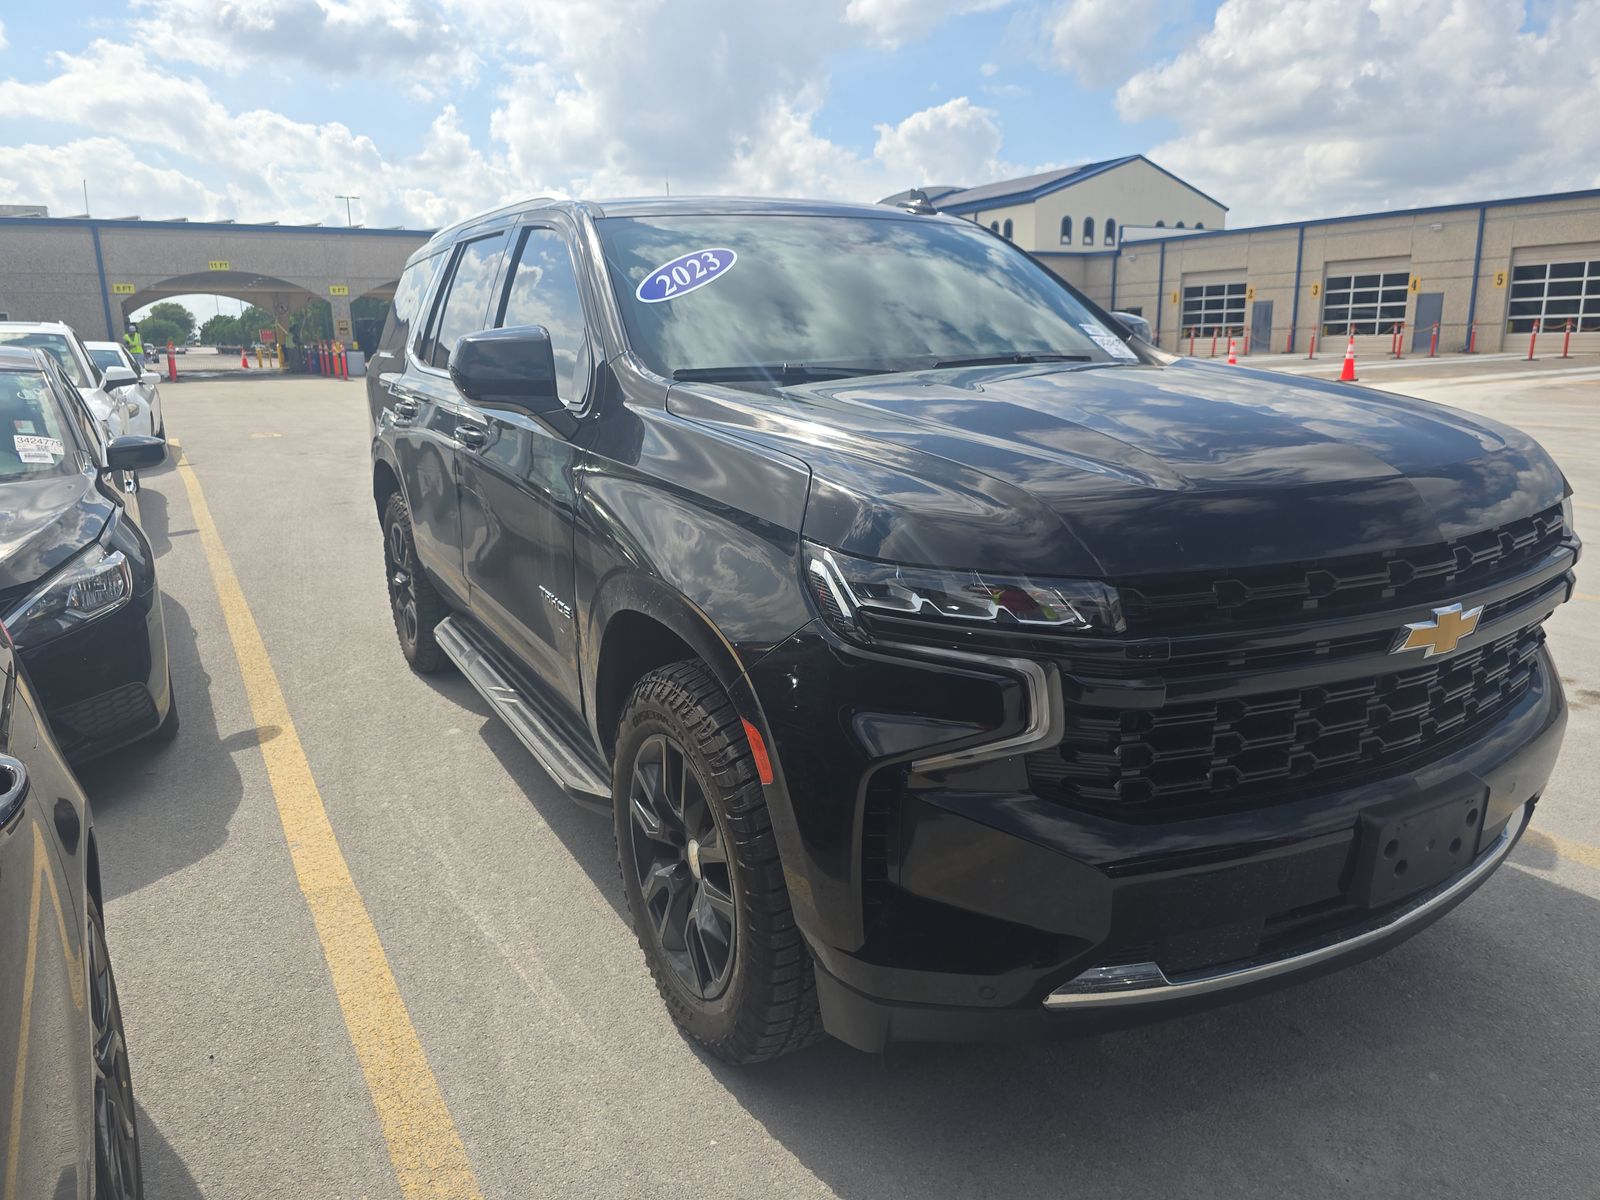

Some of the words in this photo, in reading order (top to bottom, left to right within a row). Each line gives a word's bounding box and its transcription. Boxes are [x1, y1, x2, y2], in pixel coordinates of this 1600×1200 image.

[656, 252, 720, 297] 2023
[1496, 273, 1503, 286] 5
[1312, 284, 1319, 296] 3
[1411, 279, 1417, 291] 4
[16, 436, 63, 447] 3424779
[538, 584, 572, 619] TAHOE
